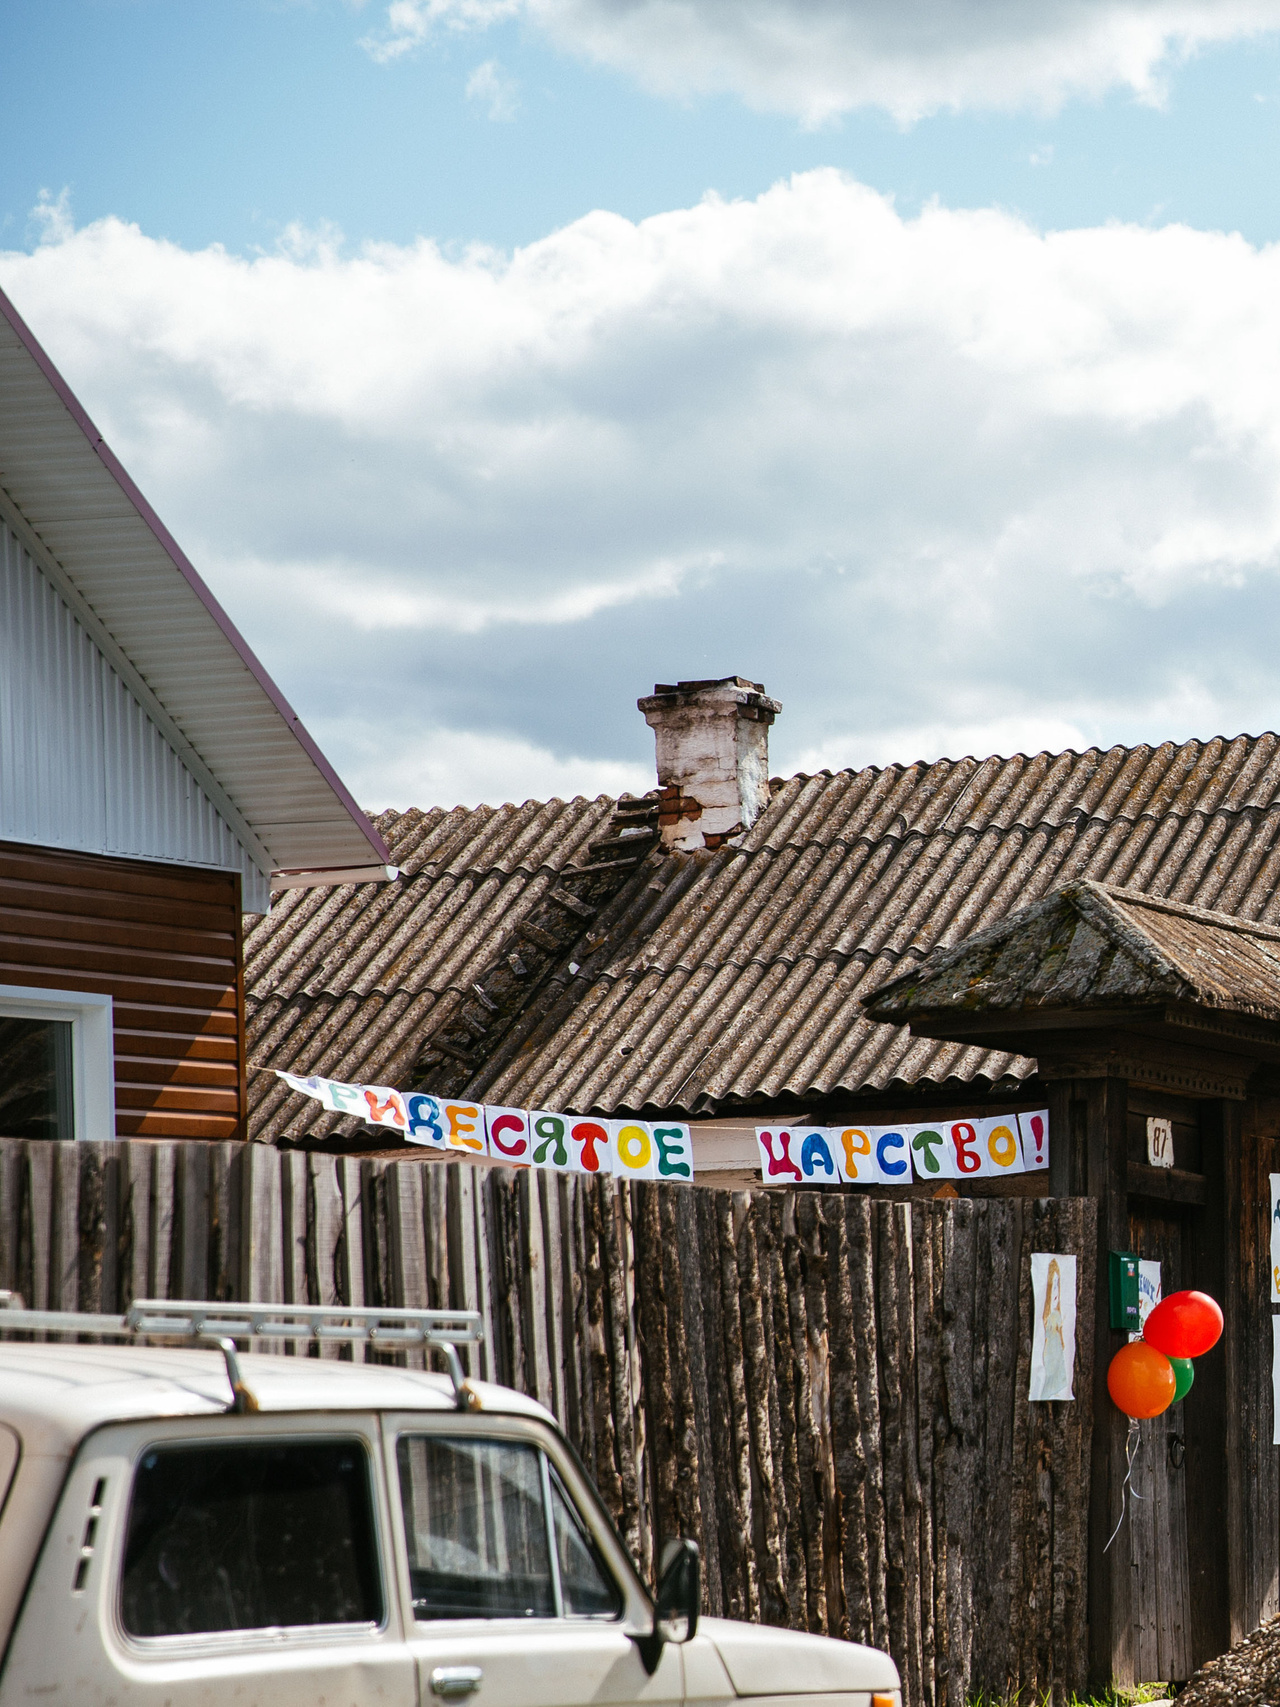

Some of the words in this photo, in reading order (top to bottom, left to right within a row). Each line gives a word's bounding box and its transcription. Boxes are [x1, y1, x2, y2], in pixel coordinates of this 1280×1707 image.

[286, 1077, 690, 1177] РИДЕСЯТОЕ
[760, 1115, 1043, 1181] ЦАРСТВО!
[1153, 1126, 1166, 1158] 87
